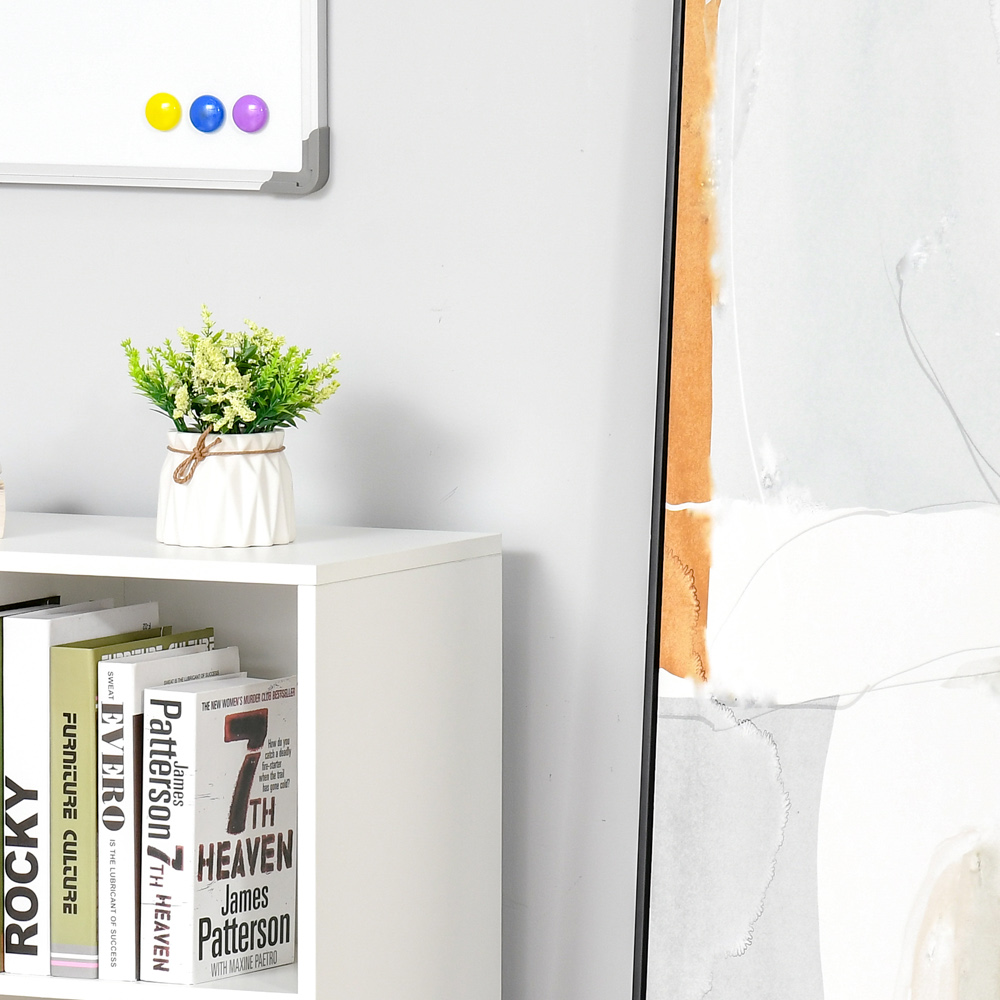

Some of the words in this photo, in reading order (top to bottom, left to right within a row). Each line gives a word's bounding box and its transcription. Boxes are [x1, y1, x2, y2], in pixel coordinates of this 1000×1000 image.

[107, 671, 115, 700] SWEAT
[201, 701, 210, 712] THE
[211, 699, 221, 710] NEW
[222, 696, 243, 709] WOMEN'S
[243, 693, 261, 705] MURDER
[267, 739, 277, 749] How
[277, 739, 283, 747] do
[279, 747, 292, 758] deadly
[62, 712, 78, 820] FURNITURE
[101, 701, 126, 831] EVERO
[148, 699, 182, 840] Patterson
[259, 773, 270, 782] when
[172, 761, 189, 807] James
[262, 783, 270, 792] has
[270, 783, 279, 793] gone
[109, 839, 116, 847] IS
[197, 829, 294, 882] HEAVEN
[4, 775, 39, 956] ROCKY
[63, 829, 78, 915] CULTURE
[221, 884, 269, 916] James
[110, 915, 117, 927] OF
[152, 894, 172, 972] HEAVEN
[198, 913, 290, 962] Patterson
[211, 960, 228, 978] WITH
[229, 954, 254, 974] MAXINE
[255, 949, 278, 969] PAETRO
